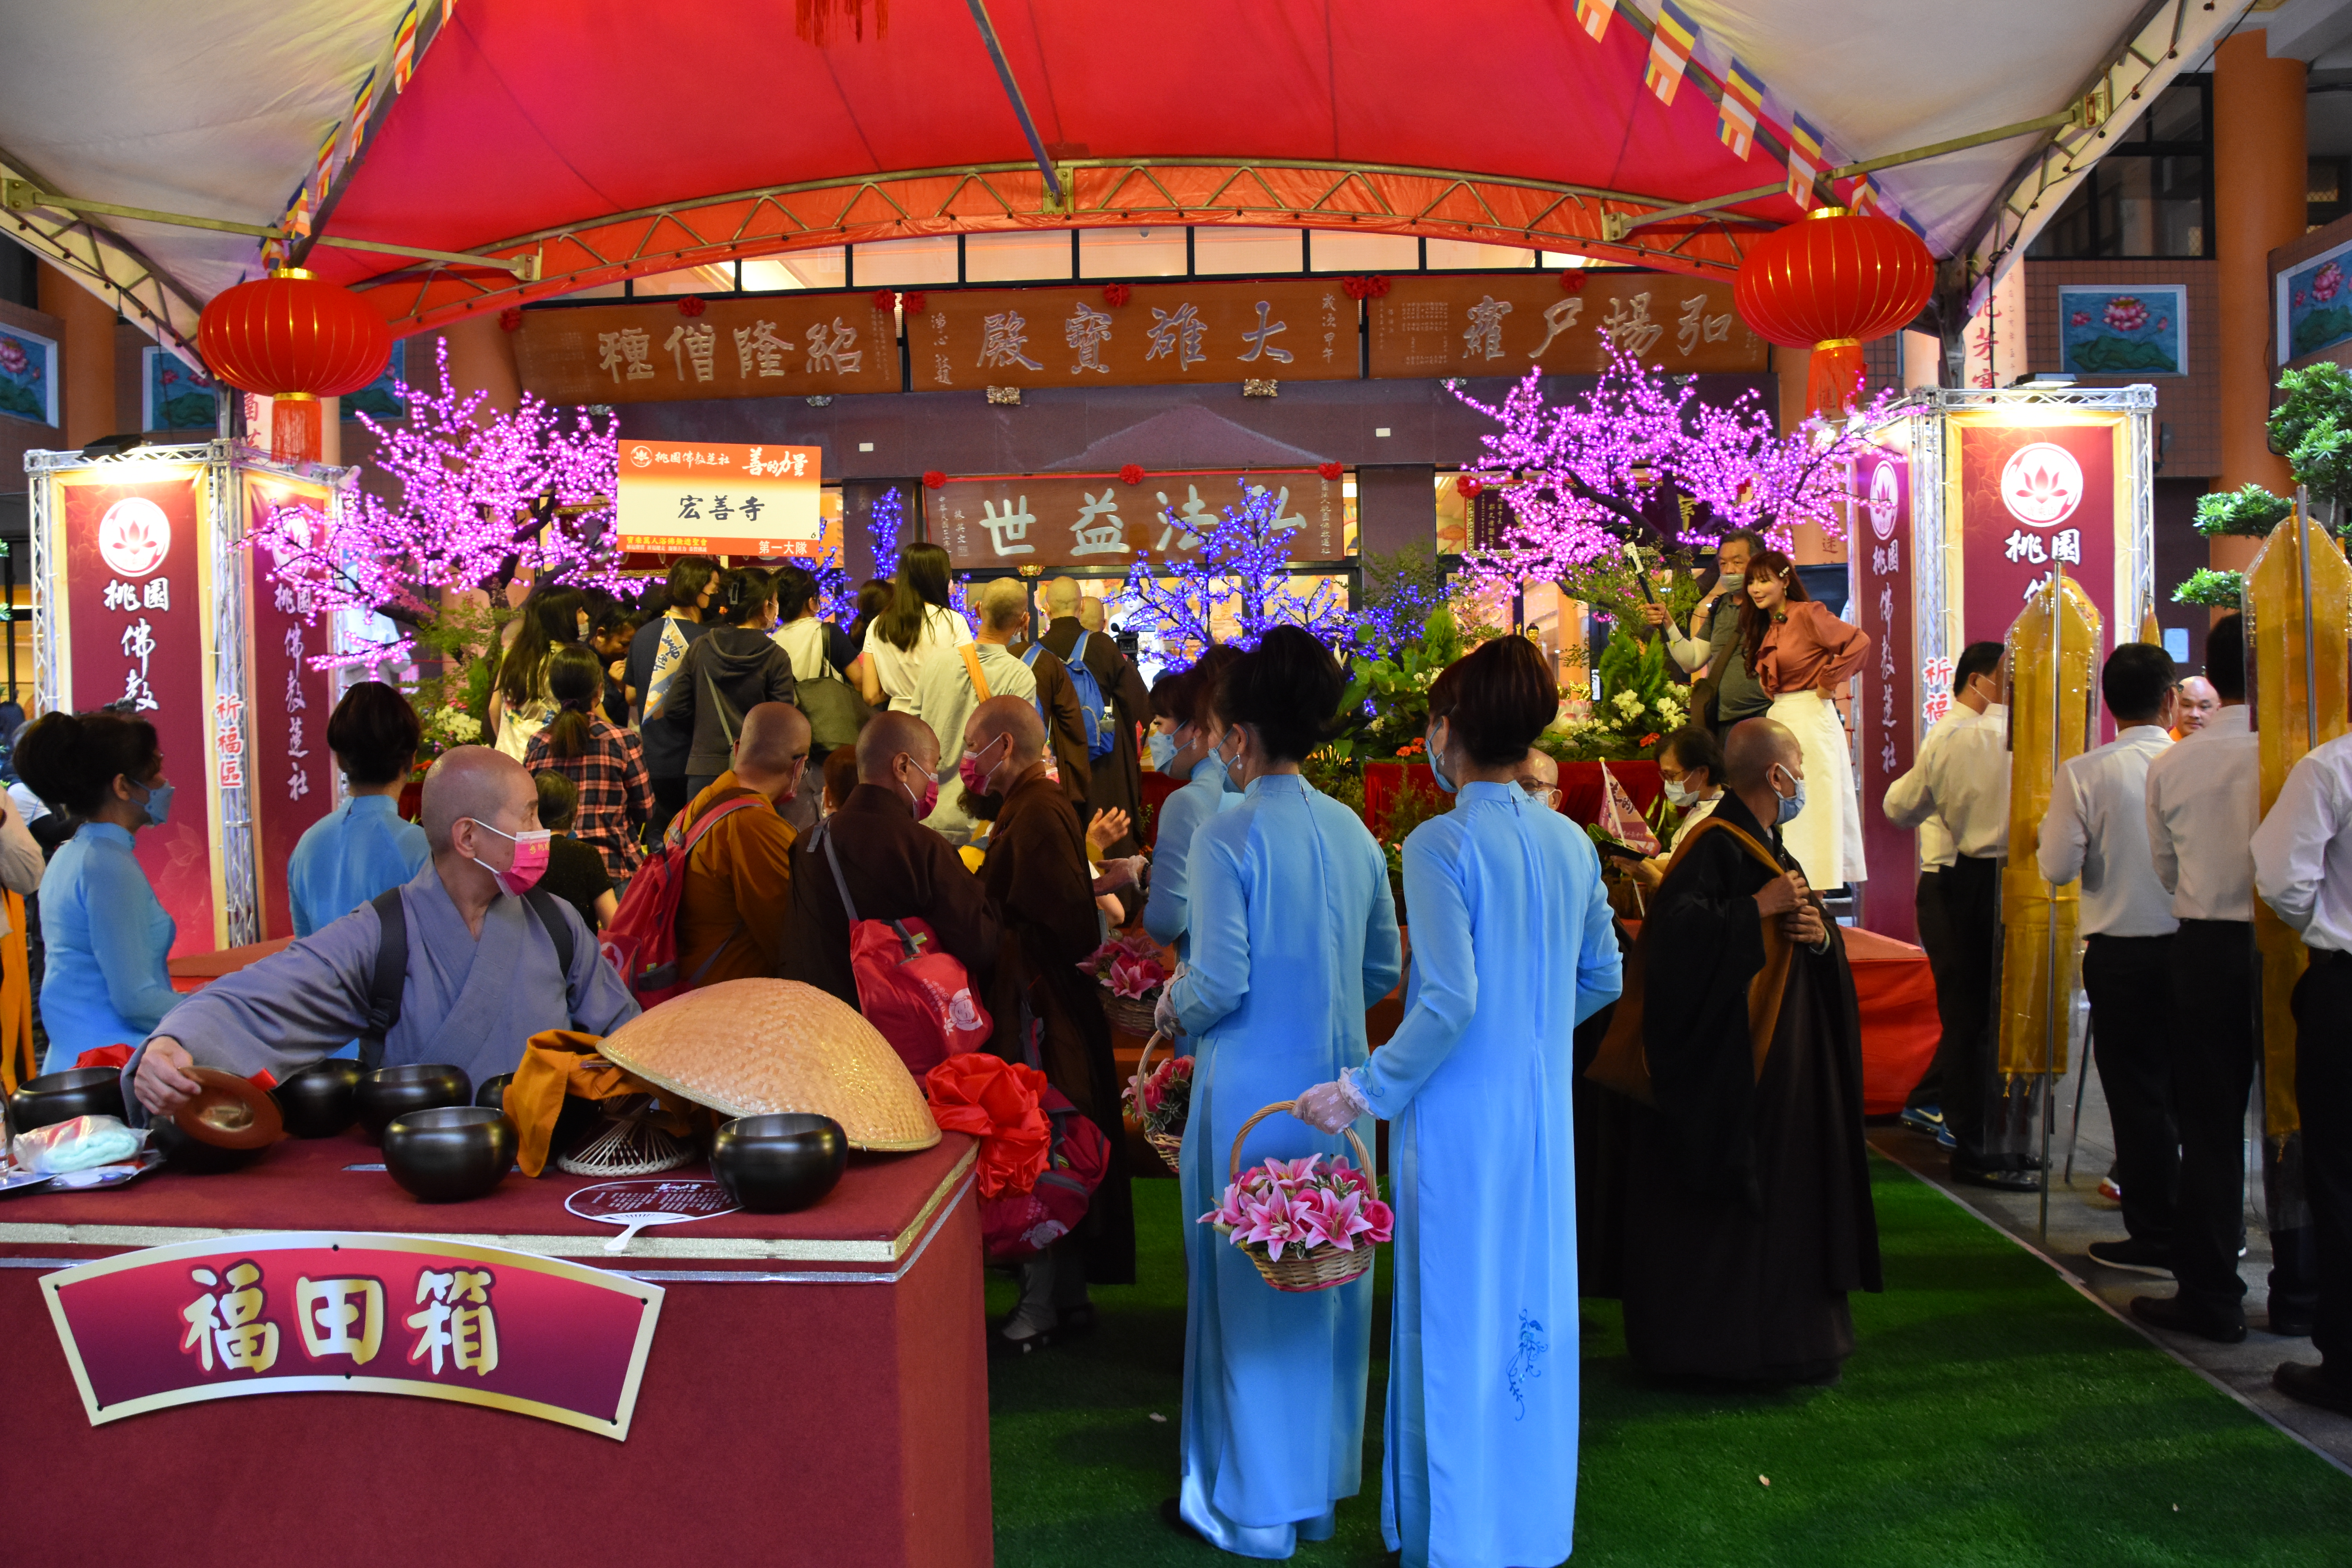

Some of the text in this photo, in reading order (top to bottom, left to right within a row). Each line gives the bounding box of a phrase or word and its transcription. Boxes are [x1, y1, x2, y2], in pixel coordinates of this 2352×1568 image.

[599, 316, 862, 383] 紹隆僧種
[977, 301, 1294, 374] 大雄寶殿
[655, 451, 730, 469] 桃園佛教蓮社
[742, 447, 808, 477] 善的力量
[678, 495, 765, 521] 宏善寺
[979, 485, 1307, 556] 弘法益世
[759, 541, 808, 555] 第一大隊
[1872, 538, 1899, 575] 桃園
[2005, 529, 2081, 564] 桃園
[103, 577, 169, 612] 桃園
[274, 583, 311, 614] 桃園
[1880, 582, 1896, 774] 佛教蓮社
[283, 621, 310, 802] 佛教蓮社
[216, 694, 244, 787] 祈福區
[181, 1263, 499, 1376] 福田箱
